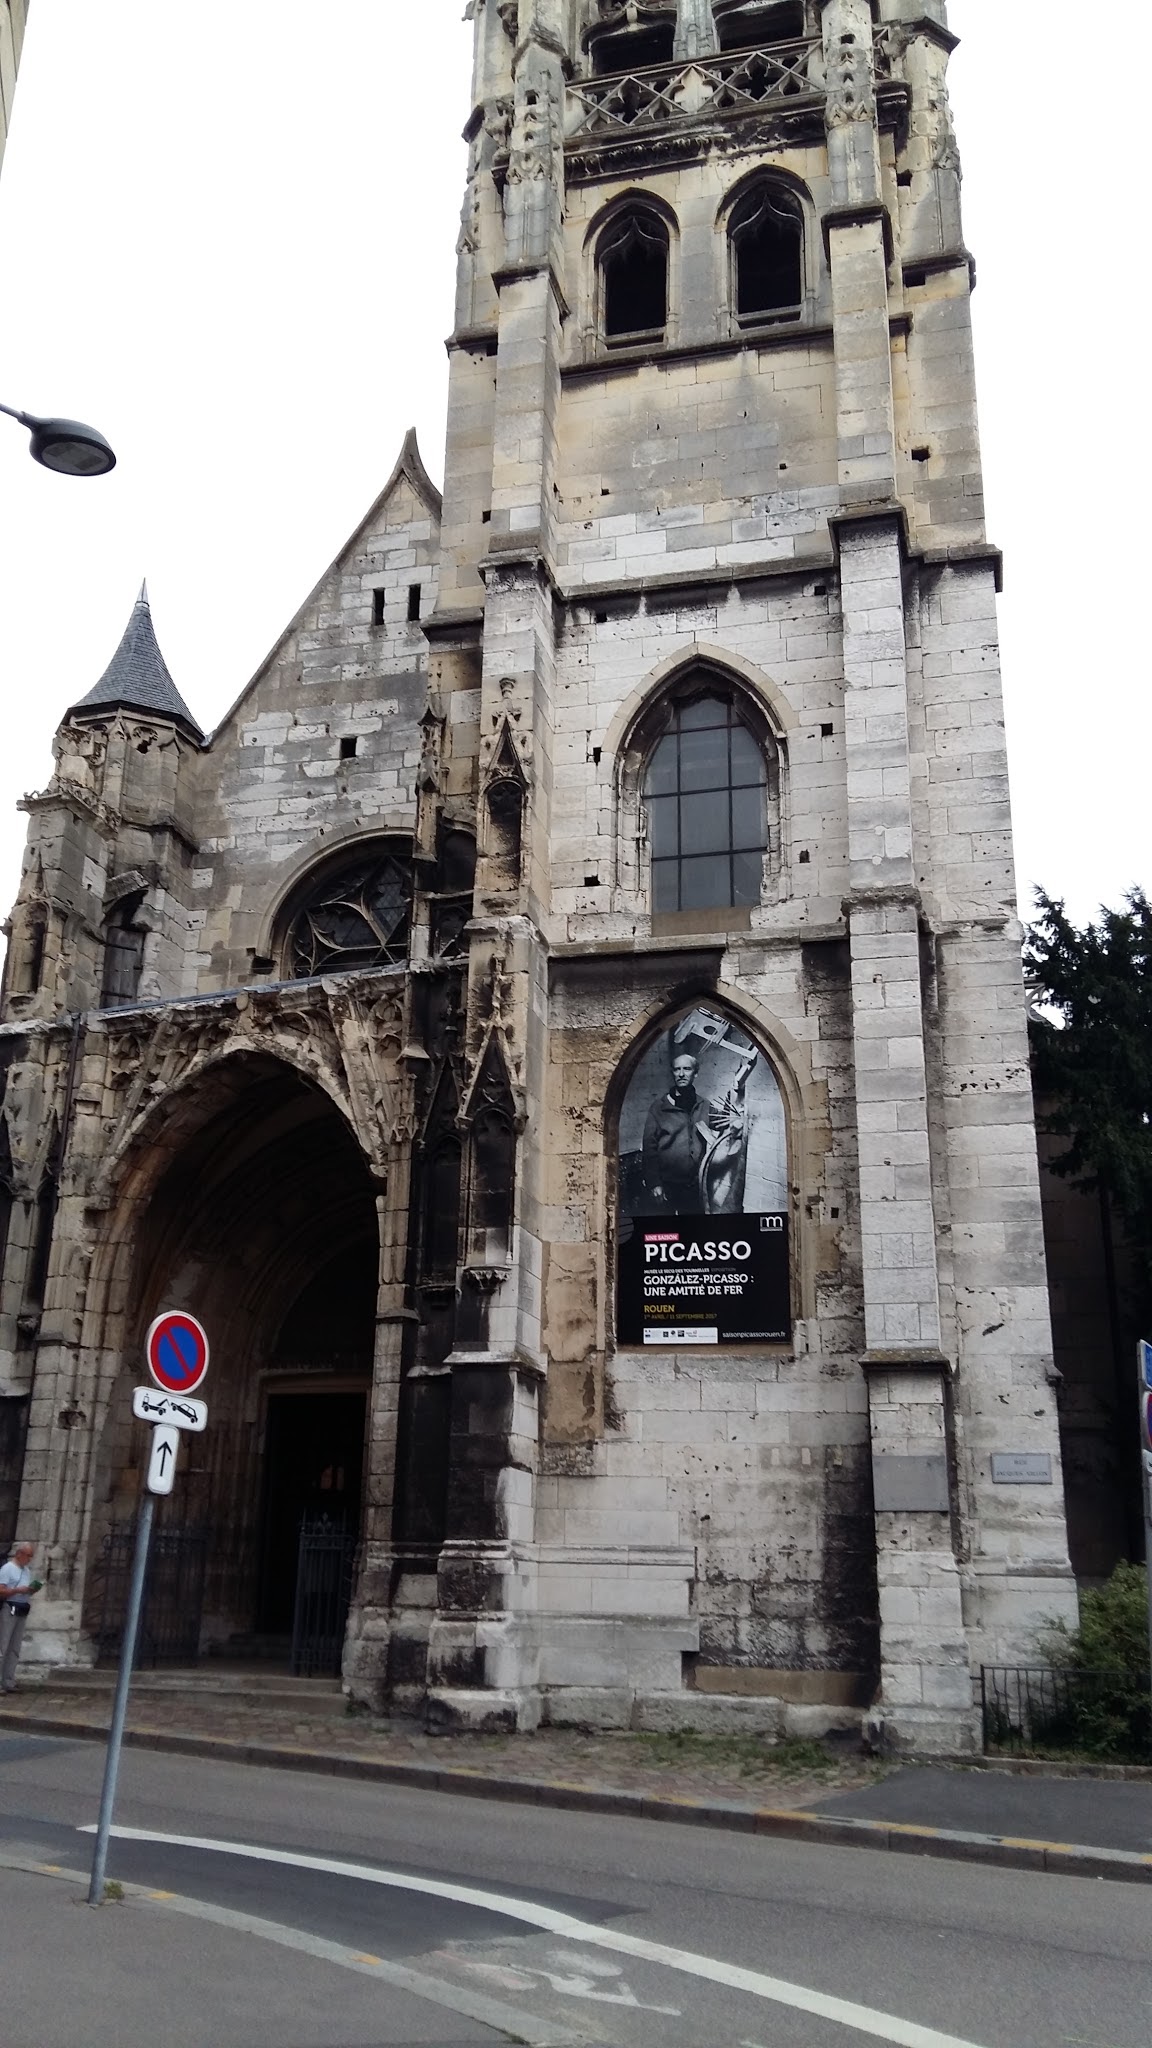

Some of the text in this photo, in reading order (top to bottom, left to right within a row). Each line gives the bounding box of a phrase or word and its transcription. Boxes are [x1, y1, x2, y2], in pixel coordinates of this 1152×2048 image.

[658, 1233, 678, 1241] SAISON
[644, 1240, 752, 1262] PICASSO
[644, 1273, 748, 1285] GONZÁLEZ-PICASSO
[644, 1284, 743, 1296] UNE AMITIÉ DE FER
[644, 1304, 675, 1313] ROUEN
[722, 1331, 786, 1339] saisonpicassorouen.fr
